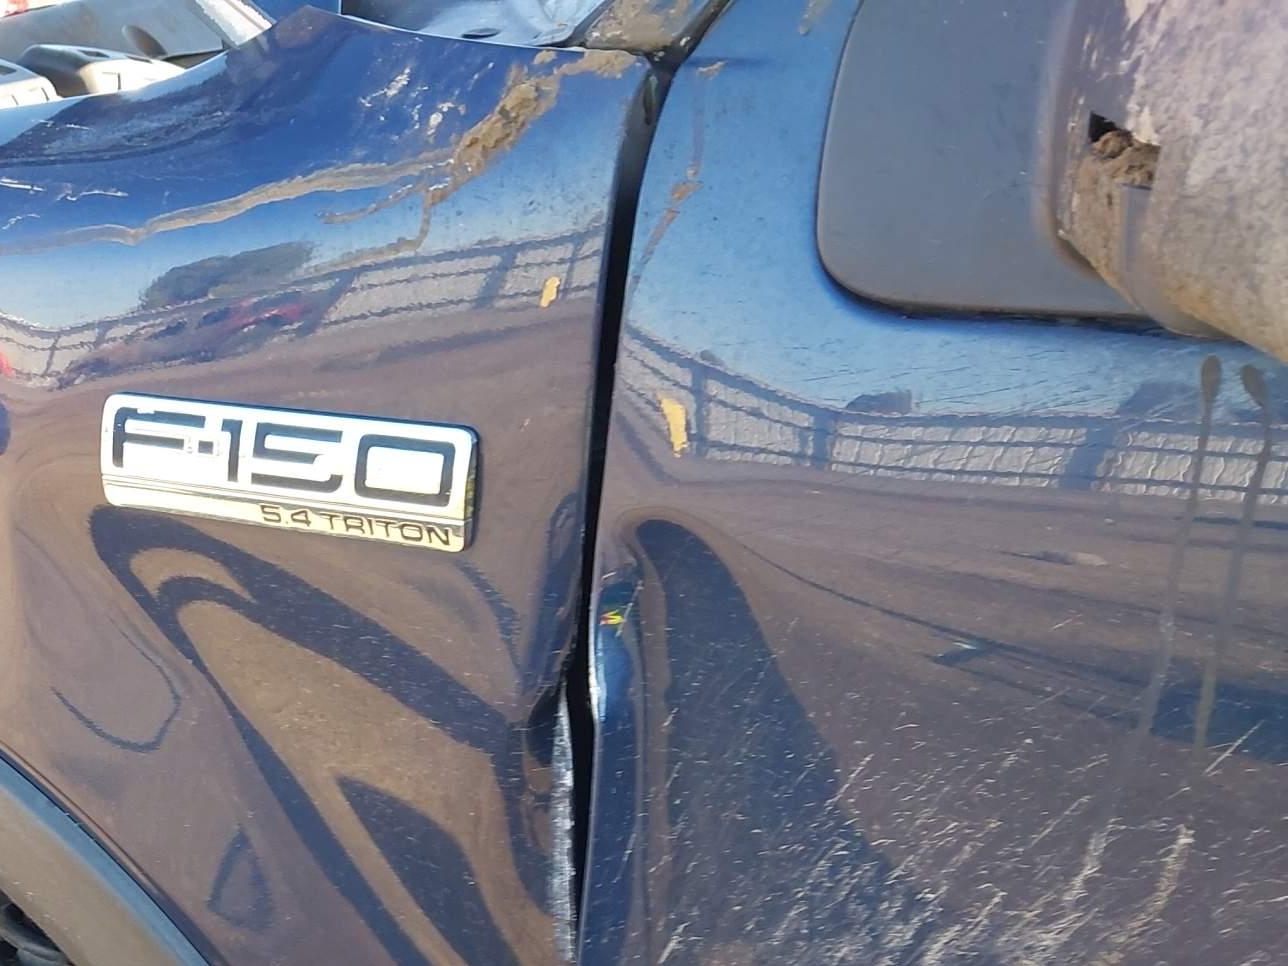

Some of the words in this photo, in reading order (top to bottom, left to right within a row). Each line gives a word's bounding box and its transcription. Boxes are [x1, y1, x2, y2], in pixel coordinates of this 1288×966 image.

[112, 406, 456, 508] F-150
[260, 503, 312, 528] 5.4
[319, 512, 451, 547] TRITON
